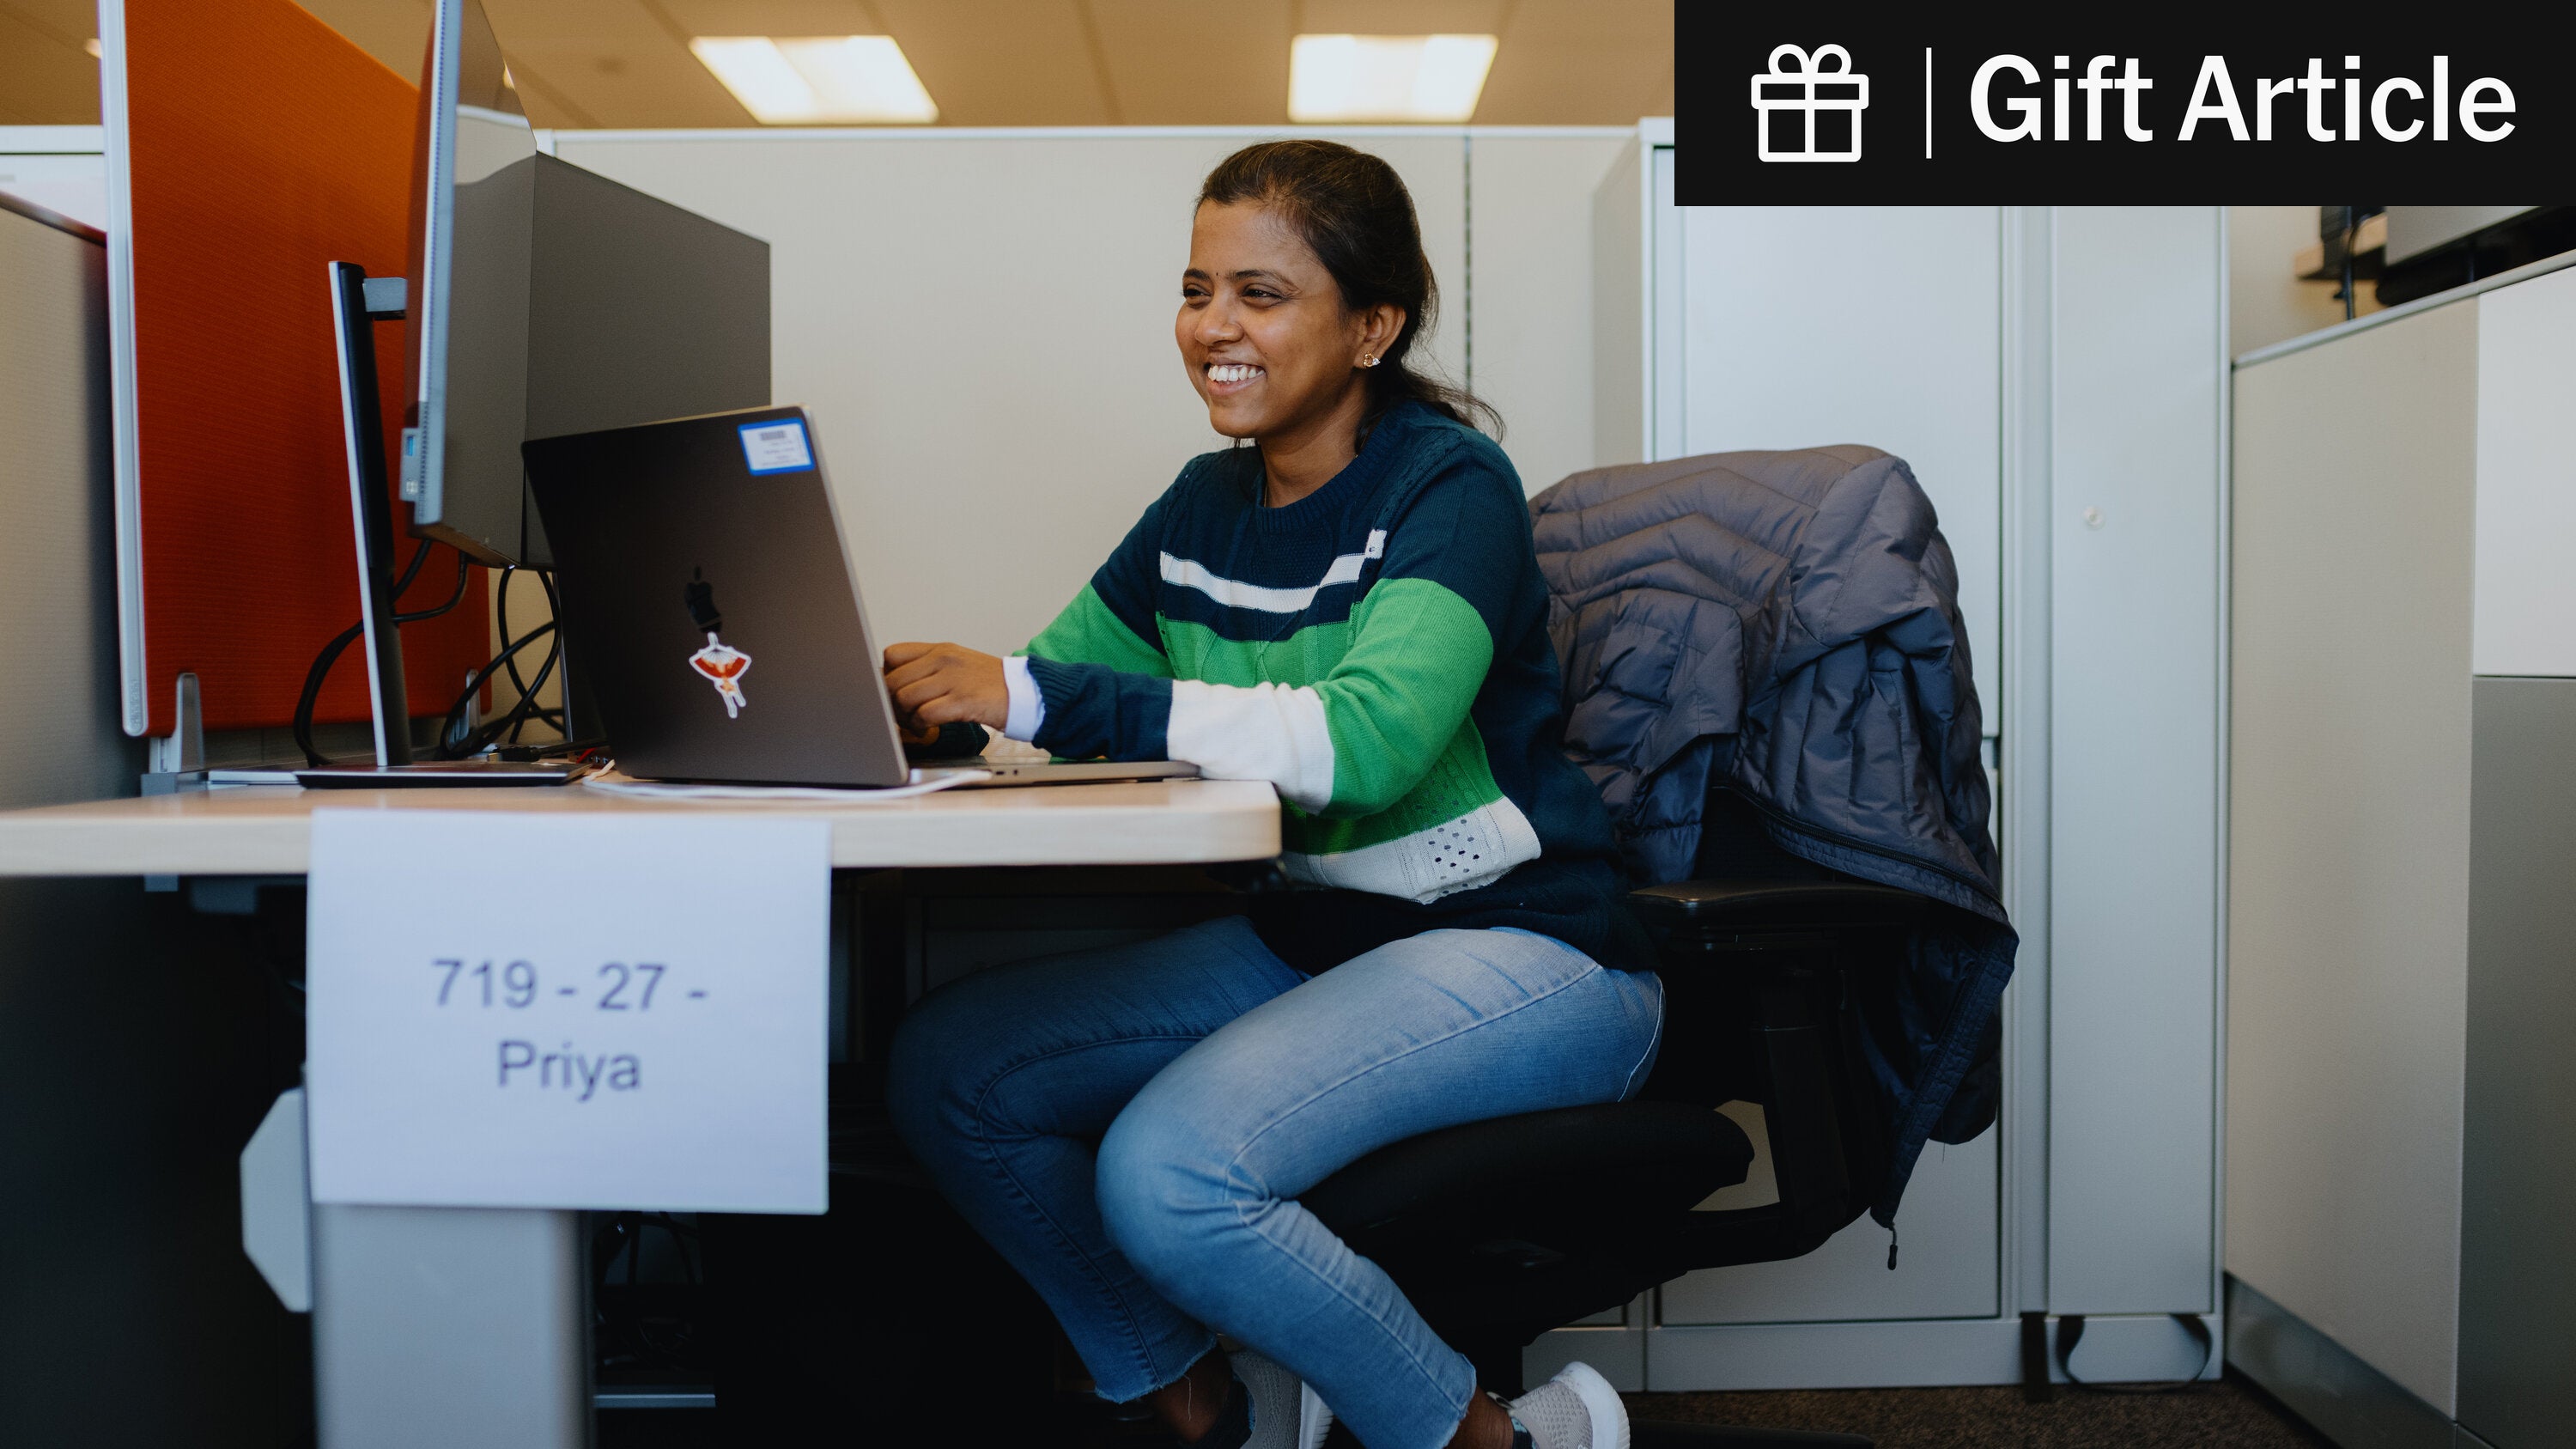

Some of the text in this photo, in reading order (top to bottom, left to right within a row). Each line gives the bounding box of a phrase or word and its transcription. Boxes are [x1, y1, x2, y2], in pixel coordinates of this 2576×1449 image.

[432, 958, 538, 1008] 719
[598, 962, 667, 1011] 27
[498, 1039, 641, 1102] Priya
